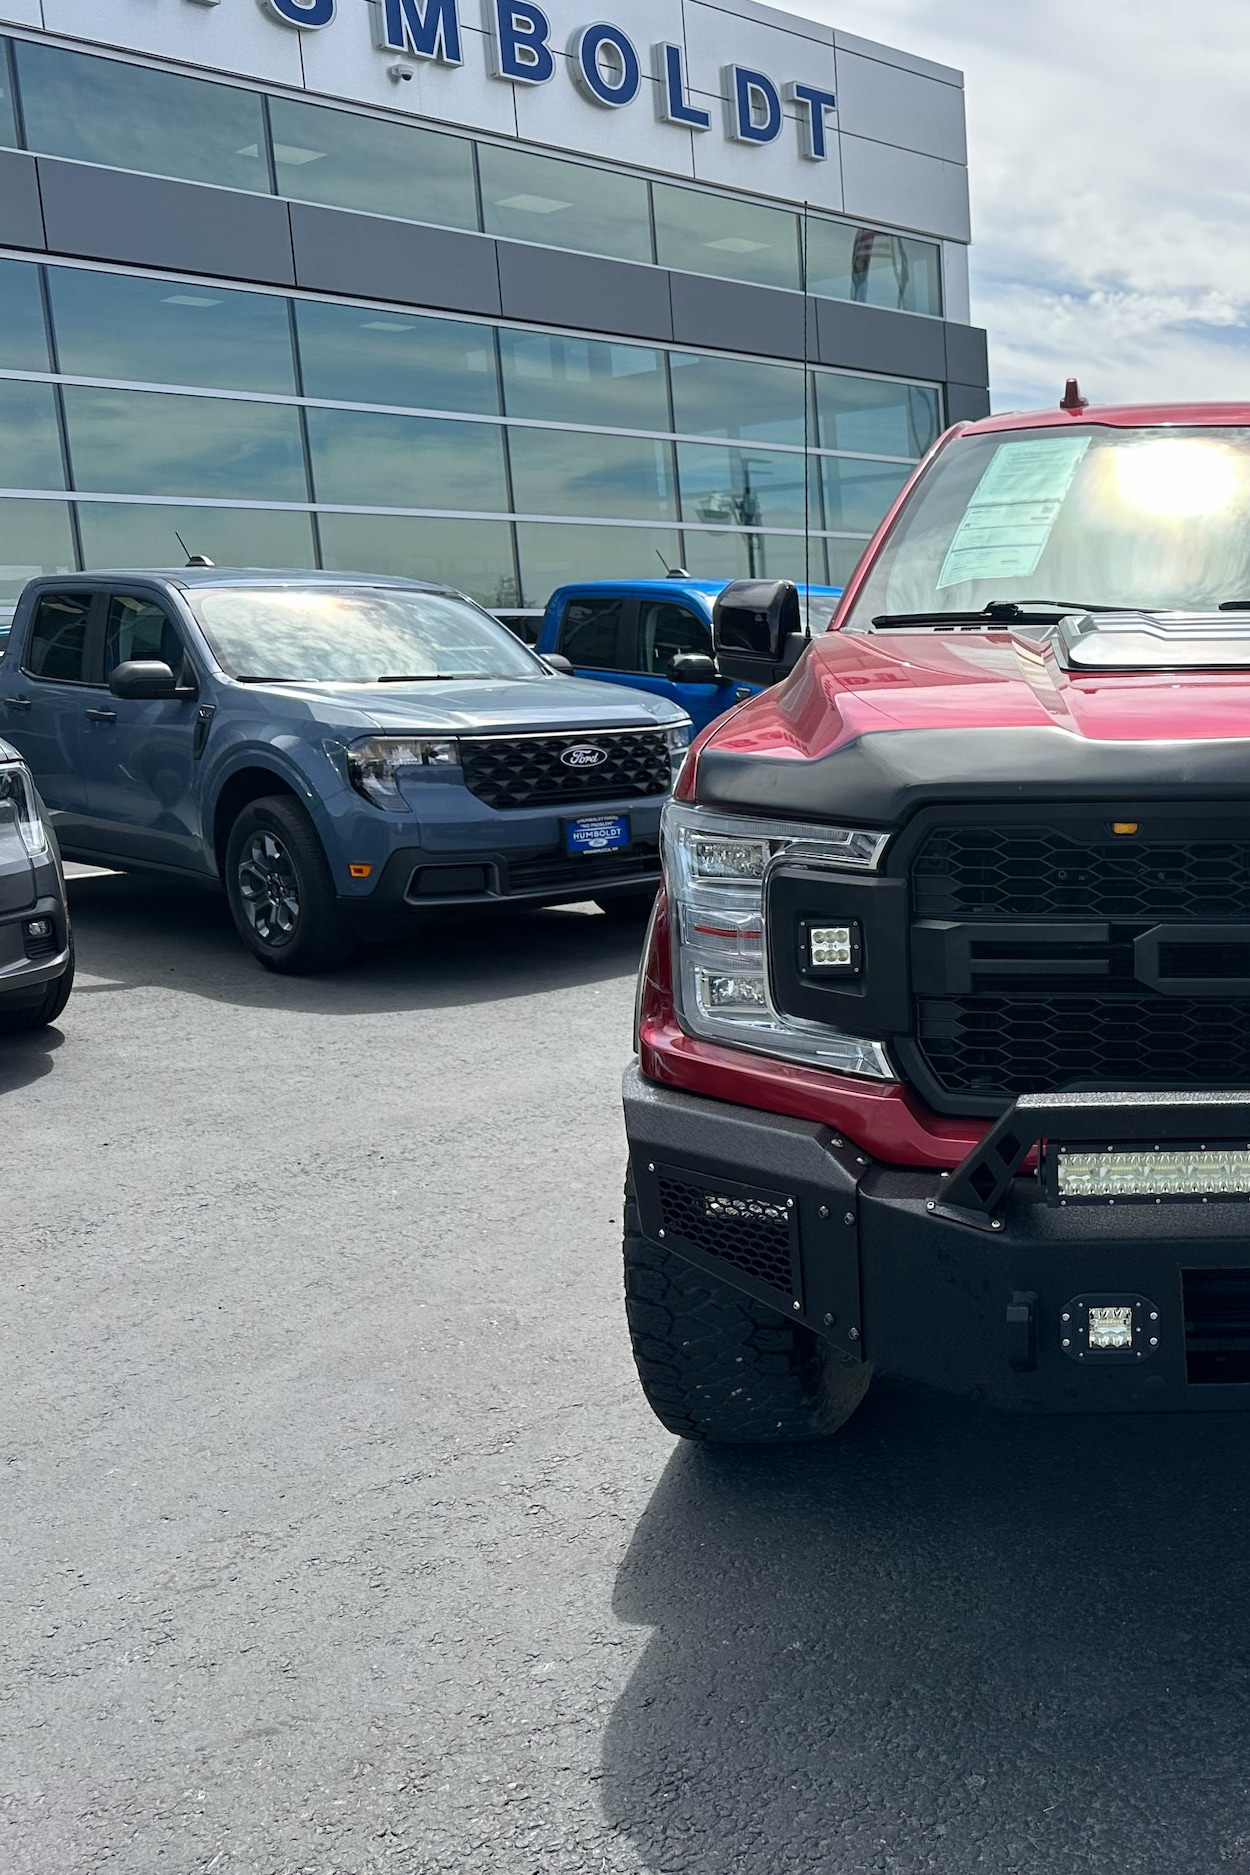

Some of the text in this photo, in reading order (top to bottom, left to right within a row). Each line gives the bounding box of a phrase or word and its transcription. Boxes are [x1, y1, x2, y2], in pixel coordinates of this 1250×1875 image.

[186, 0, 838, 162] MBOLDT
[570, 750, 599, 764] Ford
[572, 828, 622, 840] HUMBOLDT
